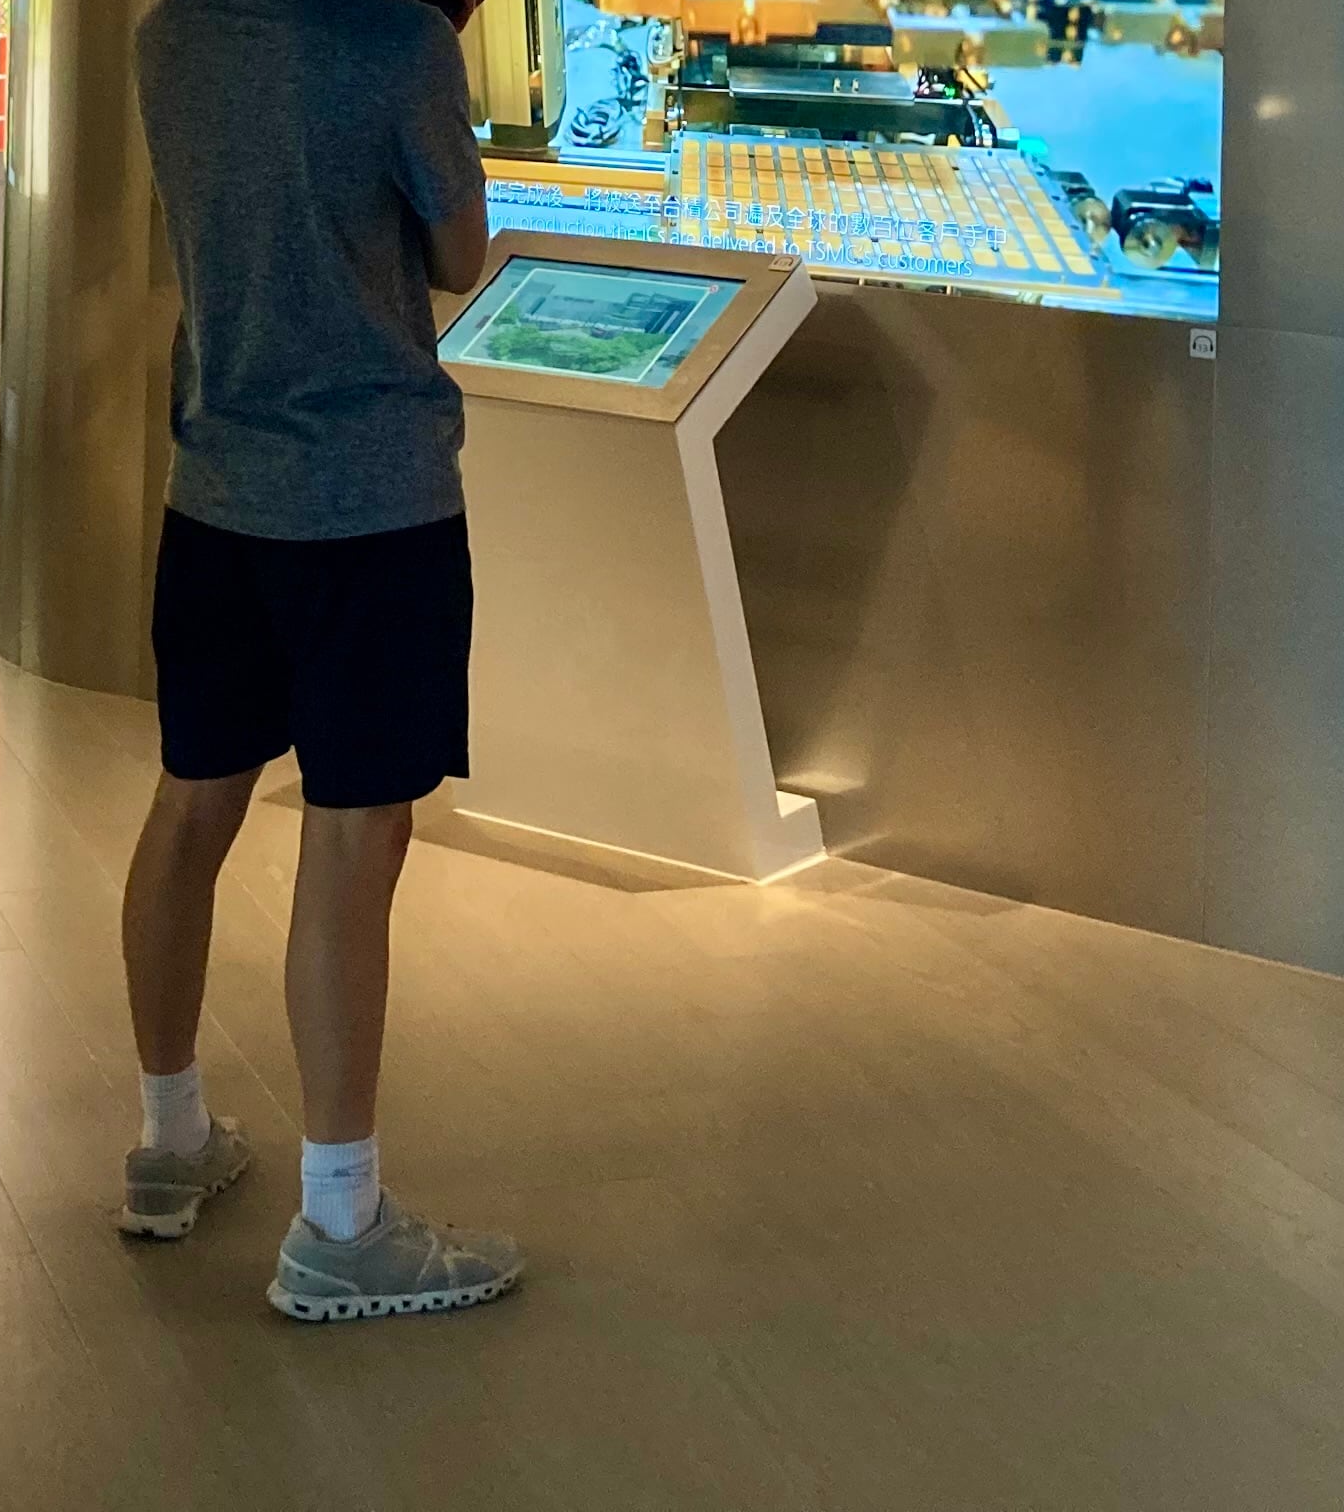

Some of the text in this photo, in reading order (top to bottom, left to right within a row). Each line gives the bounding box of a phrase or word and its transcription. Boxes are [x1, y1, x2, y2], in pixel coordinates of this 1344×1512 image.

[670, 230, 696, 247] are
[701, 228, 776, 255] delivered
[782, 239, 800, 255] to
[807, 239, 873, 267] TSMC's
[877, 248, 973, 278] customers
